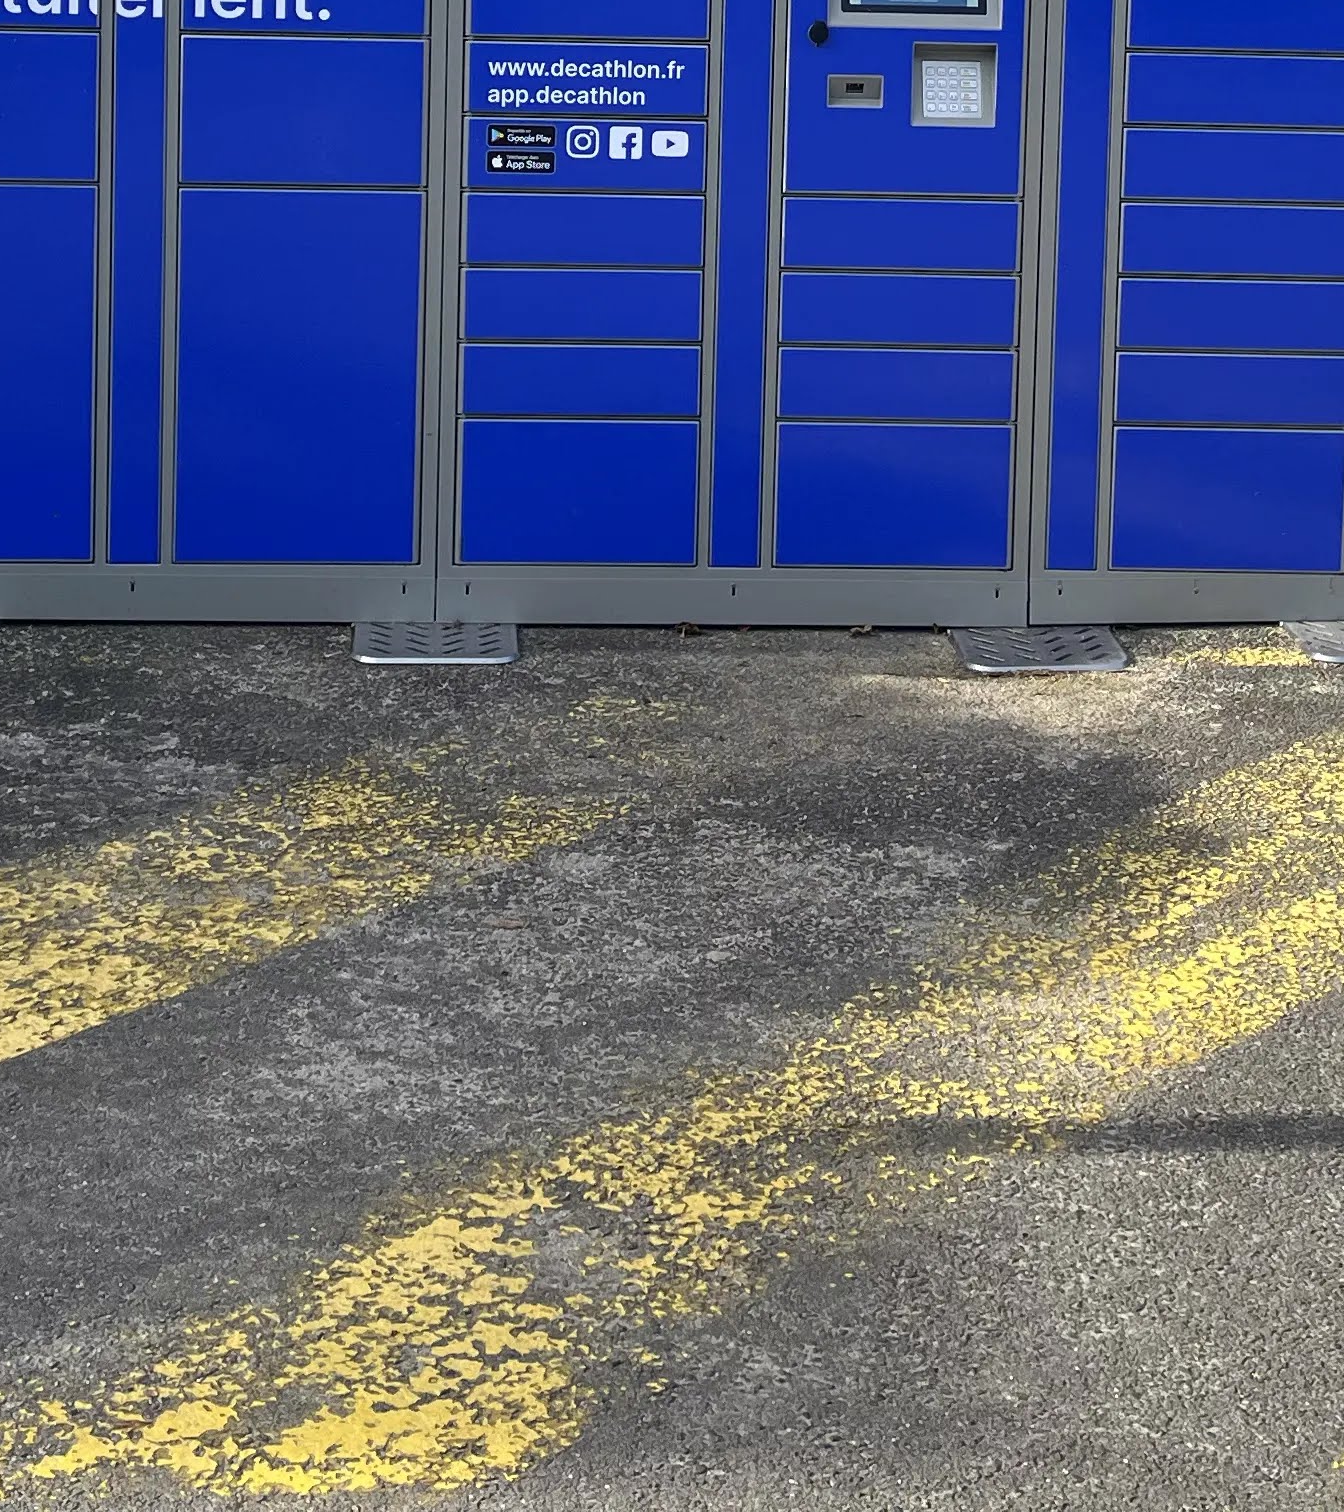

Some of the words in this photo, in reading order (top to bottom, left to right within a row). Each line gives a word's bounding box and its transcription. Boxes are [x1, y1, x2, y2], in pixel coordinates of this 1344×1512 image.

[488, 58, 686, 80] www.decathlon.fr
[487, 85, 646, 108] app.decathlon
[506, 133, 535, 144] Google
[535, 134, 552, 144] Play
[505, 159, 525, 170] App
[525, 160, 551, 170] Store
